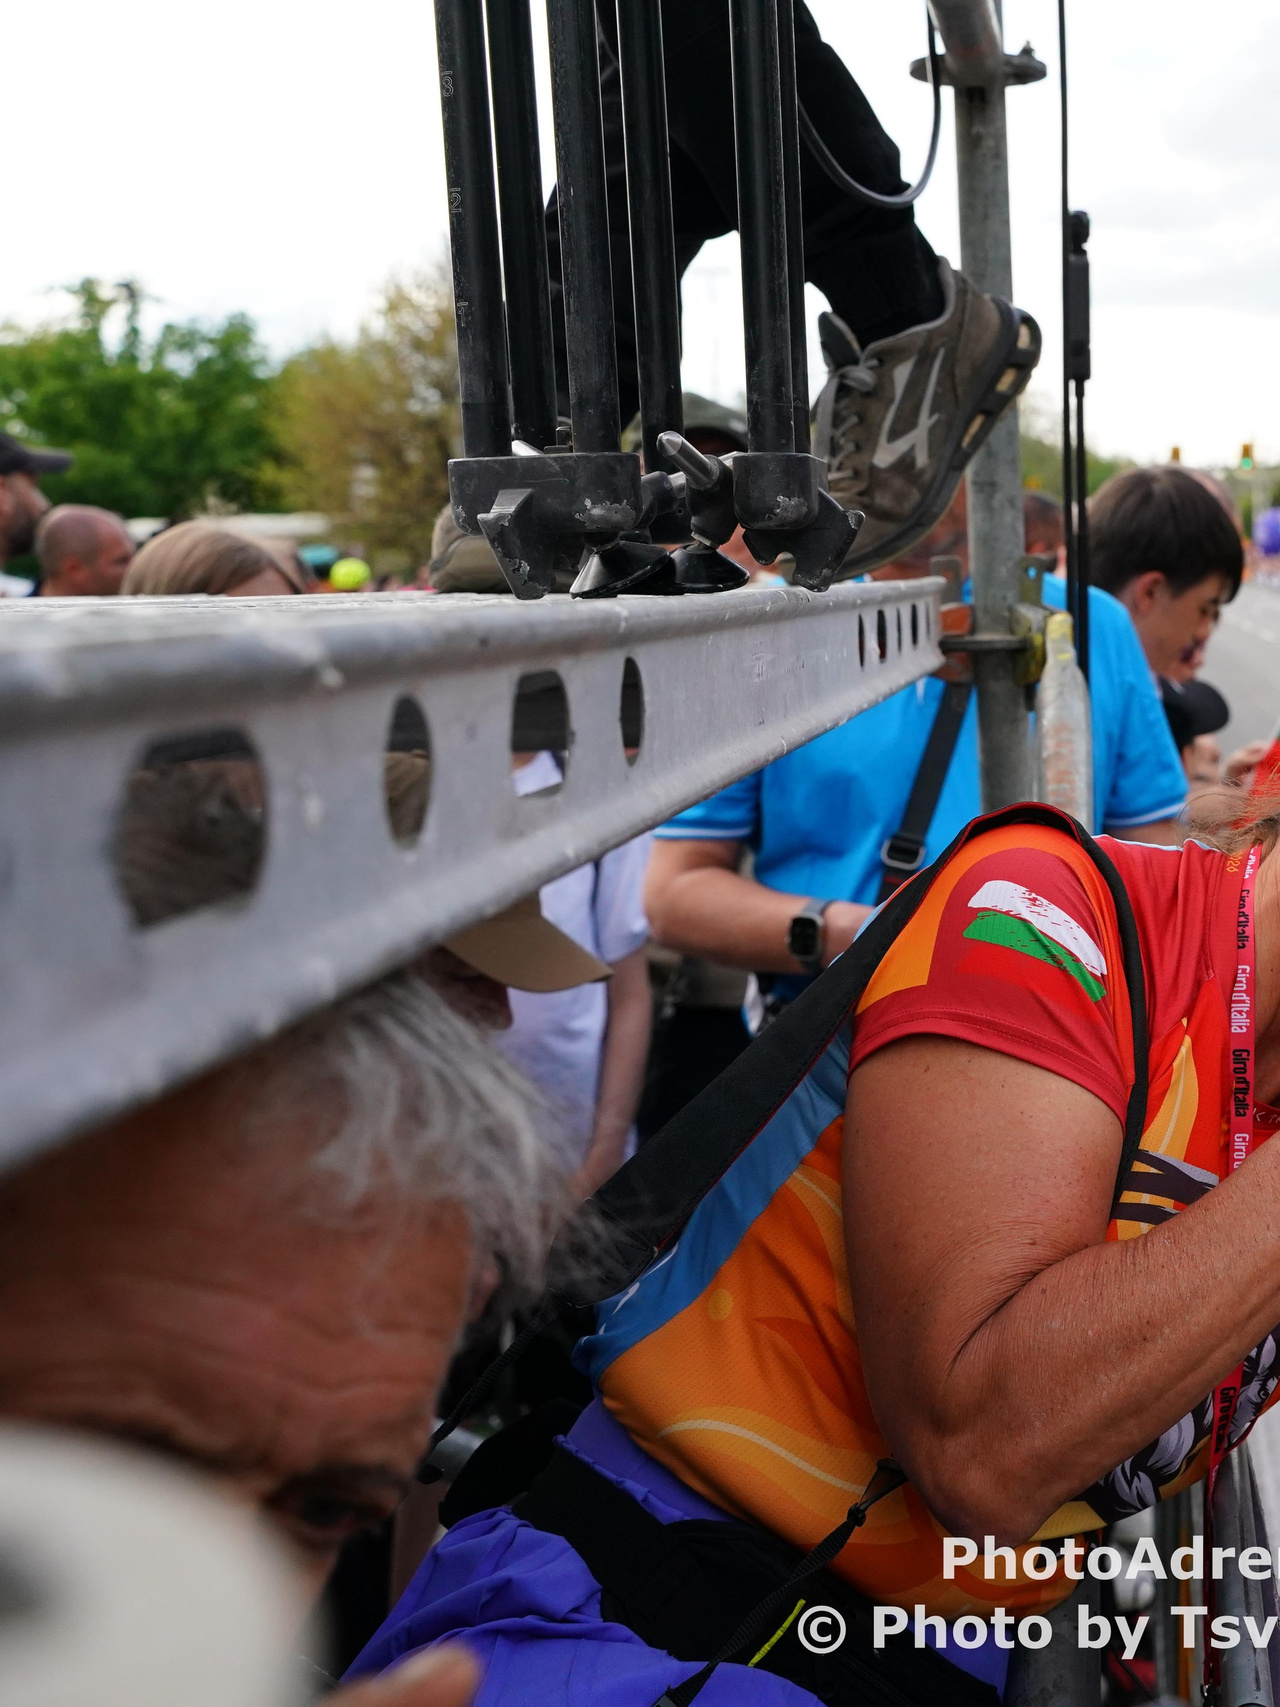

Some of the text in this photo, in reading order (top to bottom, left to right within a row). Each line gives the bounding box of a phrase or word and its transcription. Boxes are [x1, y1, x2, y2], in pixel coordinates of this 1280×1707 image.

[1231, 965, 1250, 1034] Giro d'Italia
[1232, 1048, 1250, 1118] Giro d'Italia
[1233, 1133, 1250, 1163] Giro
